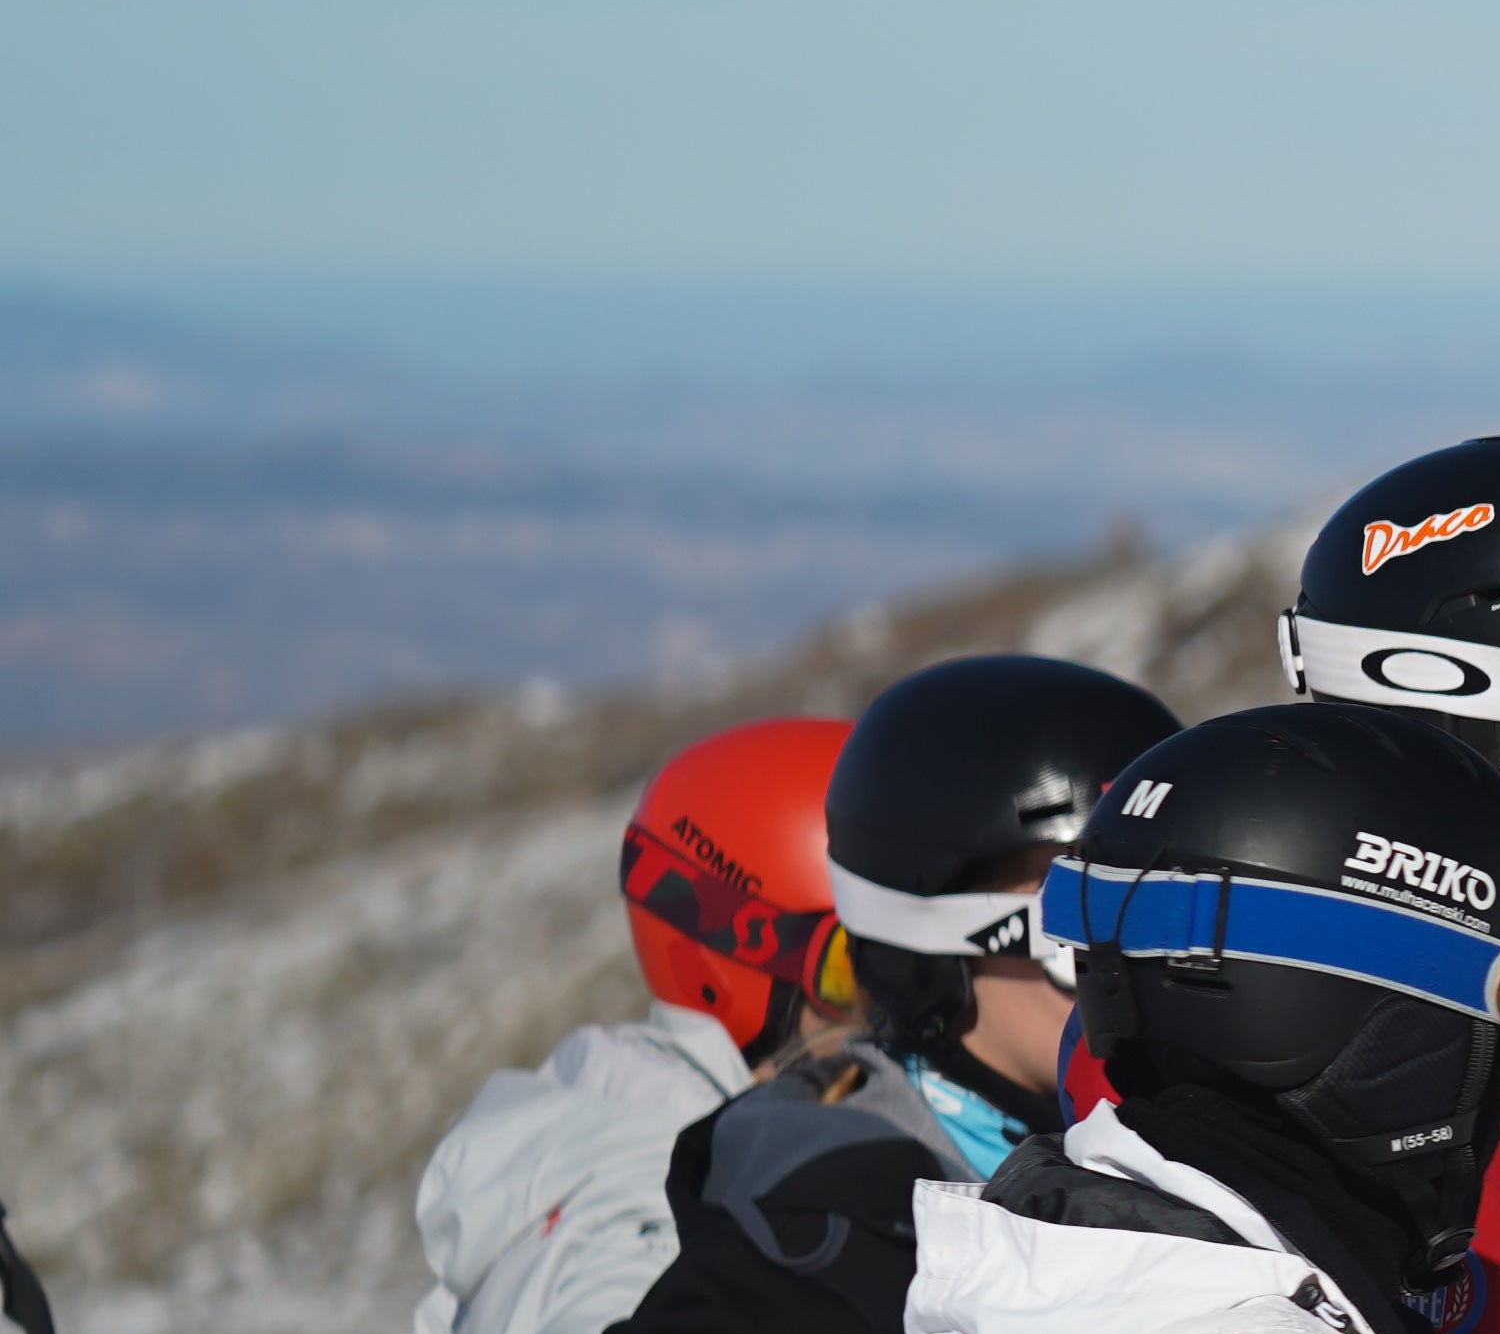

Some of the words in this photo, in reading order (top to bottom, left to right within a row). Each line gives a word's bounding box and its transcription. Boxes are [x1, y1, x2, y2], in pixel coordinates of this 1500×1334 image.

[1363, 504, 1493, 573] Draco
[1121, 779, 1173, 819] M
[671, 815, 763, 900] ATOMIC
[1344, 831, 1497, 911] BRIKO
